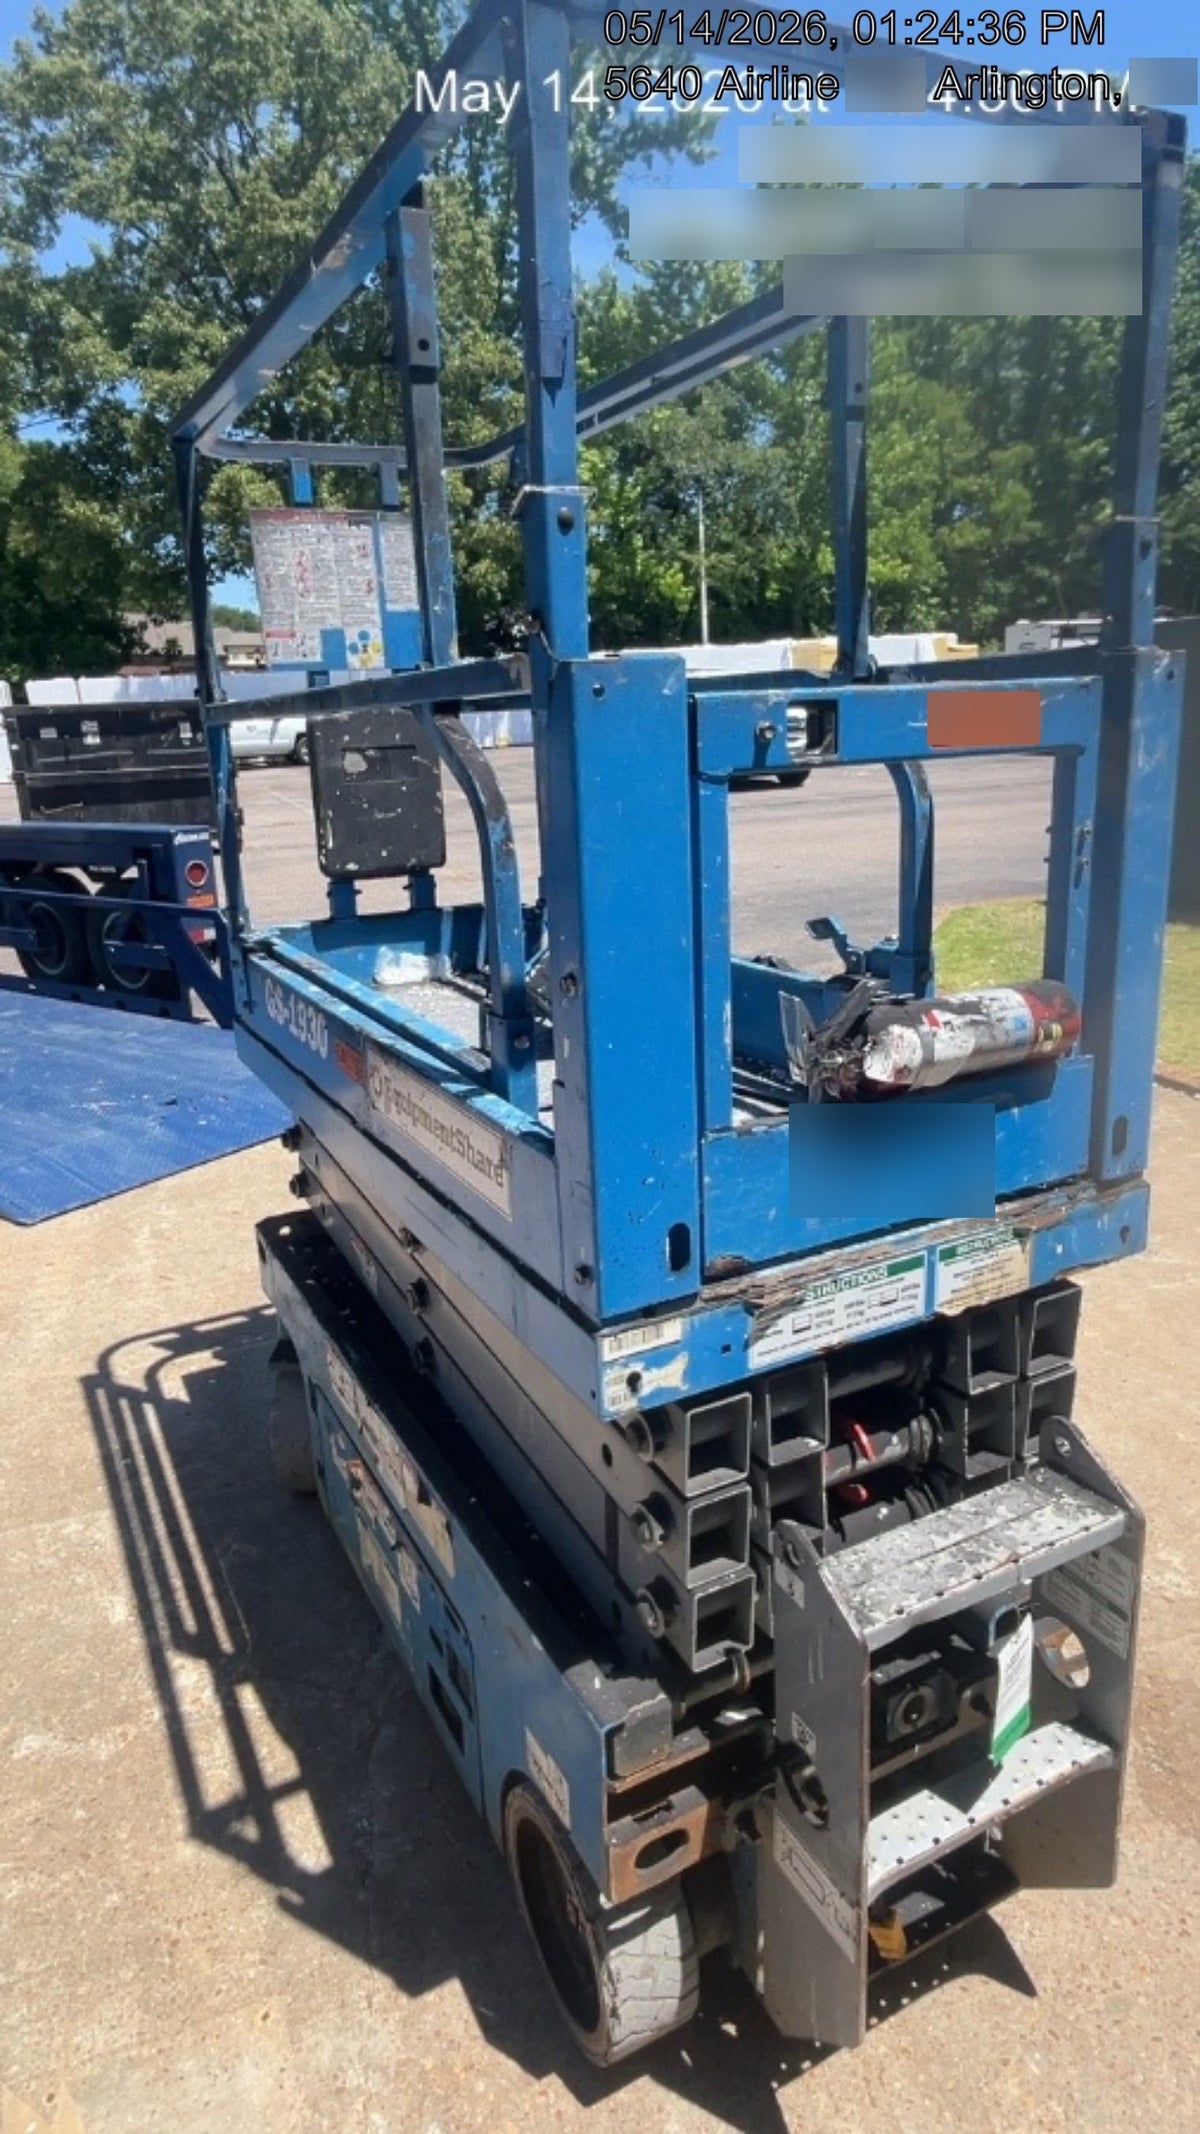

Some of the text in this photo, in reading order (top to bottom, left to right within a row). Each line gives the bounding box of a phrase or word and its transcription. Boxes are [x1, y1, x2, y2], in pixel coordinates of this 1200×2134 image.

[265, 979, 328, 1059] GS-1930
[383, 1074, 504, 1189] EquipmentShare
[804, 1264, 888, 1300] STRUCTIONS
